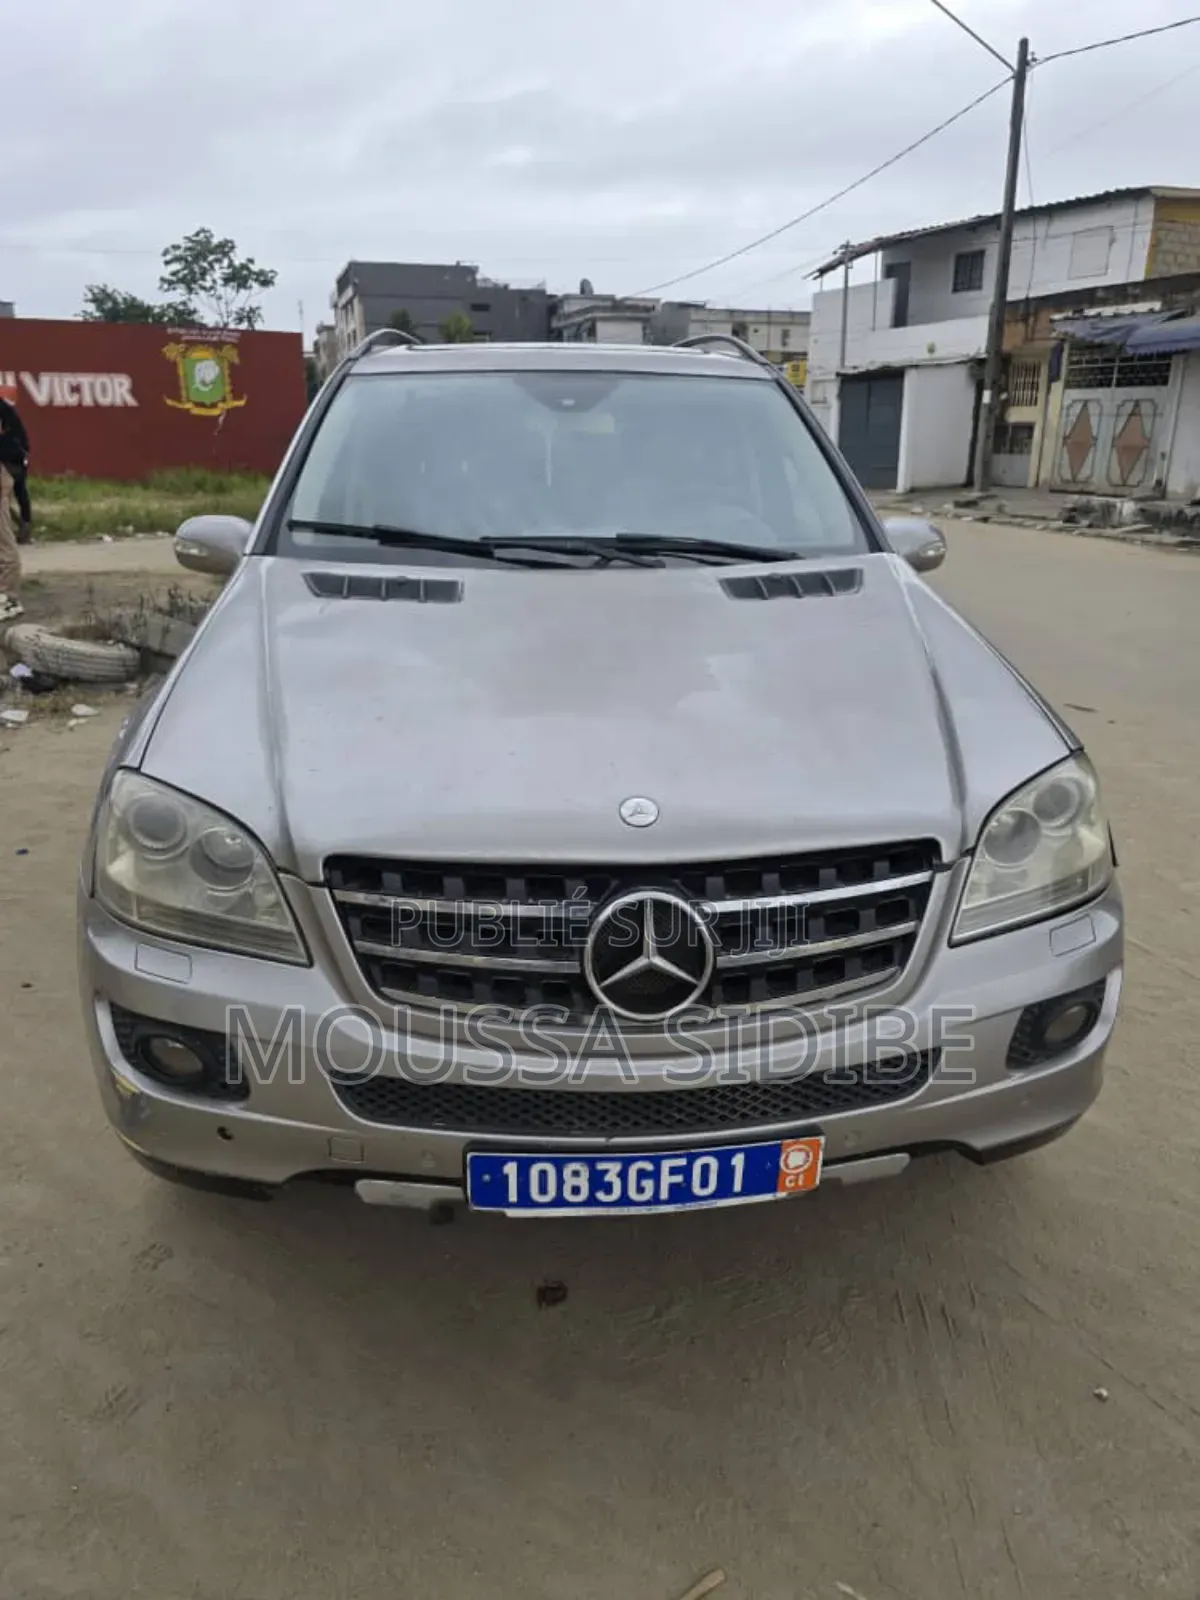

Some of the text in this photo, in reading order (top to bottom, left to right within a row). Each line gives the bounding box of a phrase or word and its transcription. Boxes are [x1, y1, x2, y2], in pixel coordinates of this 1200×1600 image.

[19, 371, 139, 407] VICTOR
[503, 1153, 745, 1203] 1083GF01
[785, 1174, 804, 1188] CI
